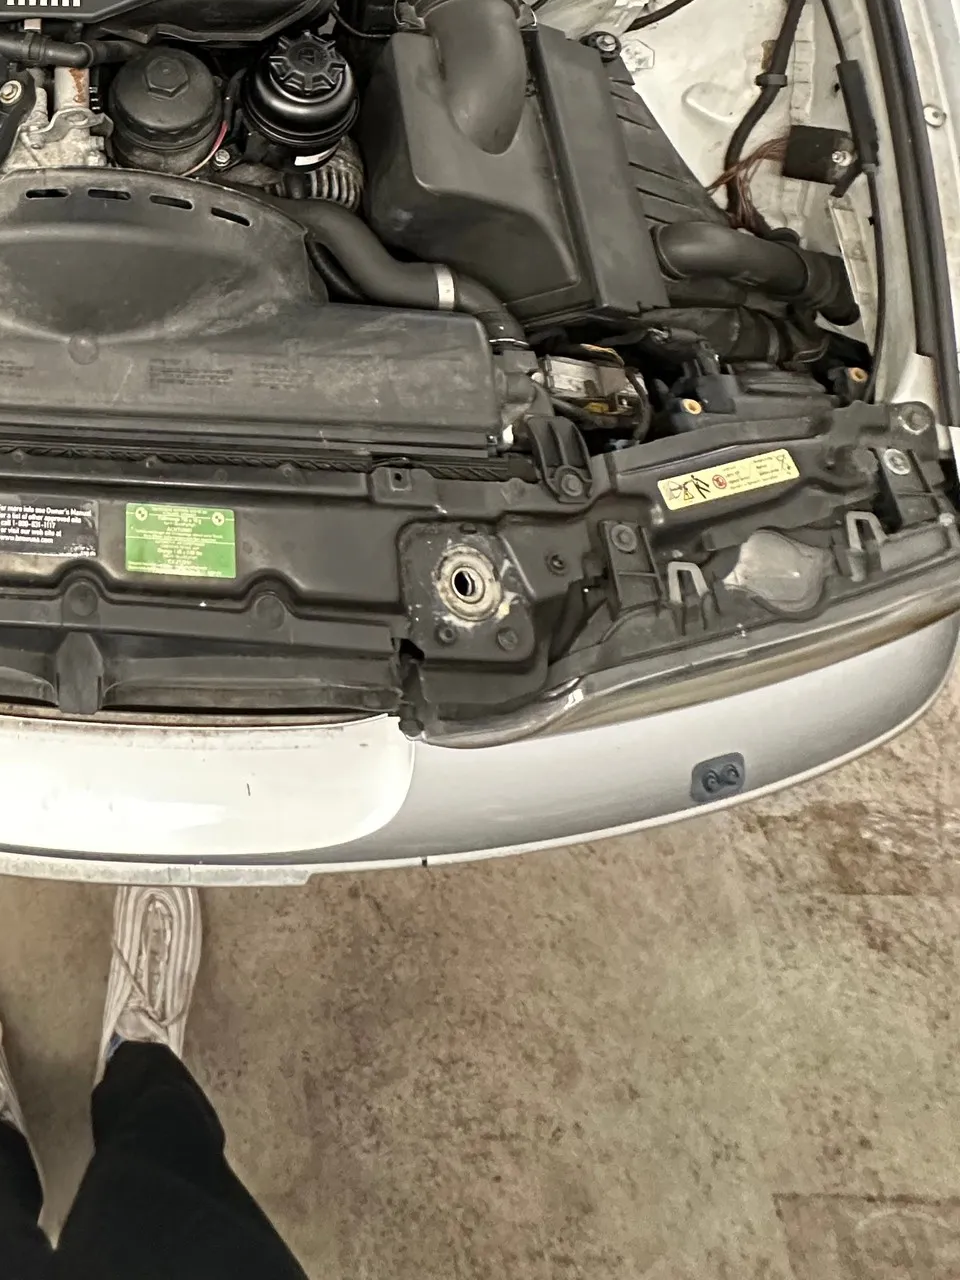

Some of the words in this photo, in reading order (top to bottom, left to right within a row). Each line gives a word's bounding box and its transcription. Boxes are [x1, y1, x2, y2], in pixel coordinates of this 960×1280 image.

[46, 507, 70, 515] Owner's
[70, 508, 92, 517] Manual
[0, 519, 11, 527] call
[28, 513, 44, 521] other
[43, 515, 70, 523] approved
